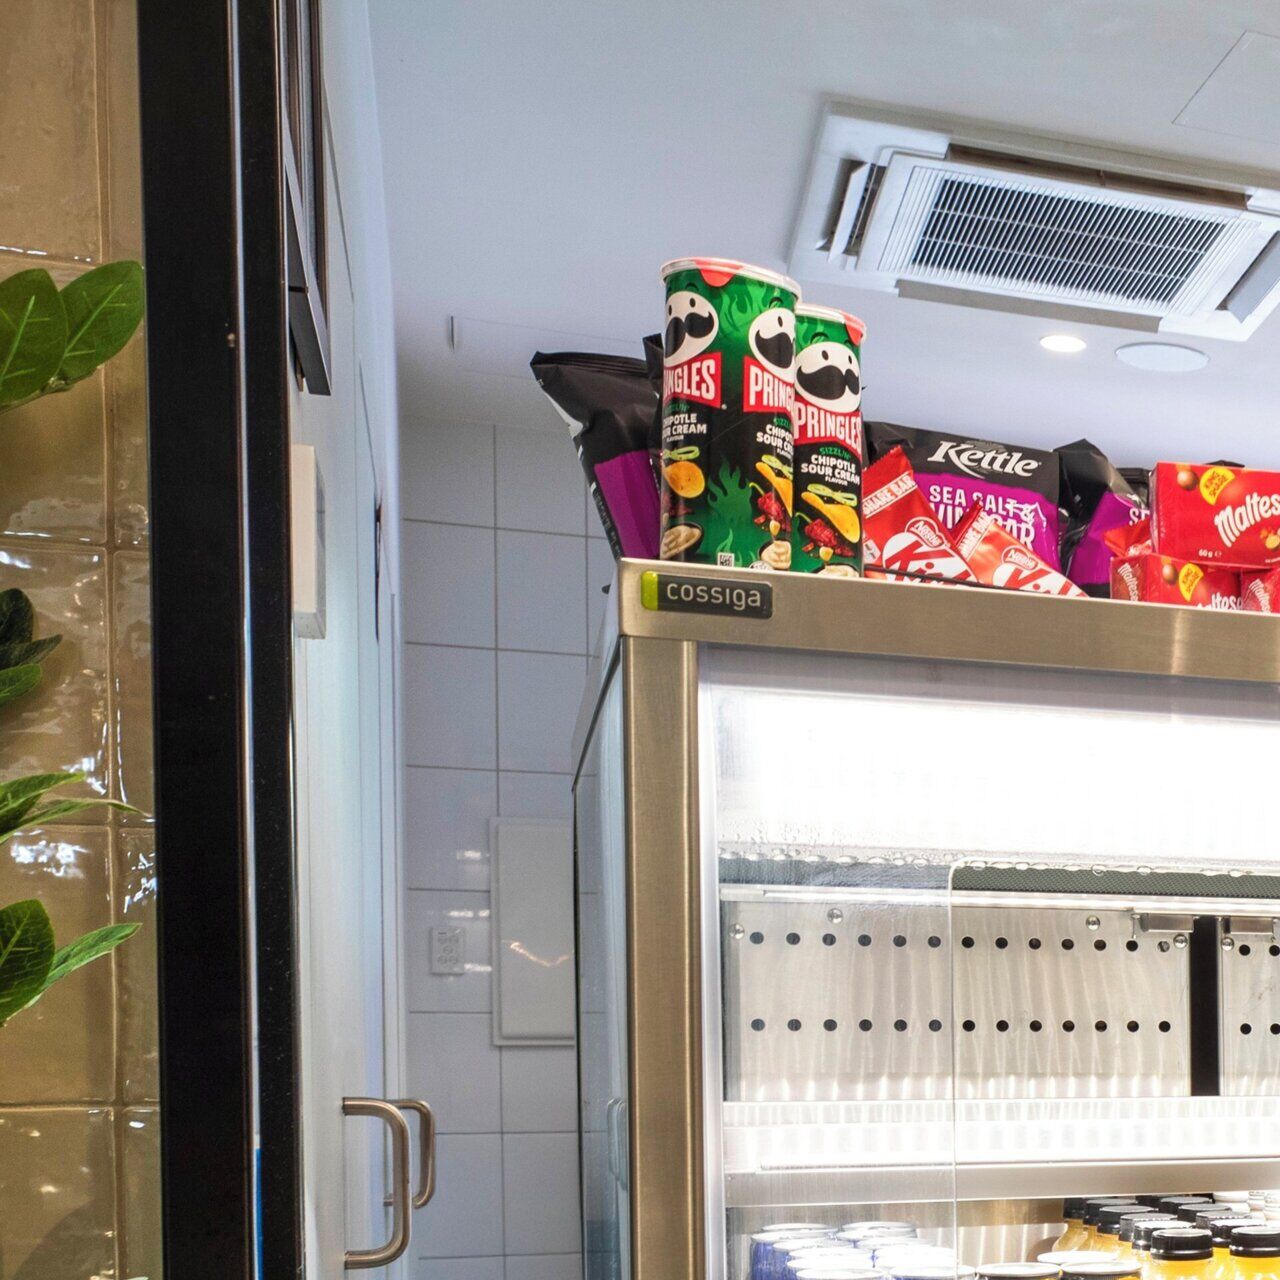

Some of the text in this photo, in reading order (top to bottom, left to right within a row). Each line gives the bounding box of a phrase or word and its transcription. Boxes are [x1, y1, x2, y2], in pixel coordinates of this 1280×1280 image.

[673, 423, 707, 435] CREAM
[757, 431, 777, 446] SOUR
[811, 454, 856, 473] CHIPOTLE
[927, 440, 1040, 479] Kettle
[801, 463, 831, 477] SOUR
[929, 485, 967, 513] SEA
[667, 583, 761, 611] cossiga
